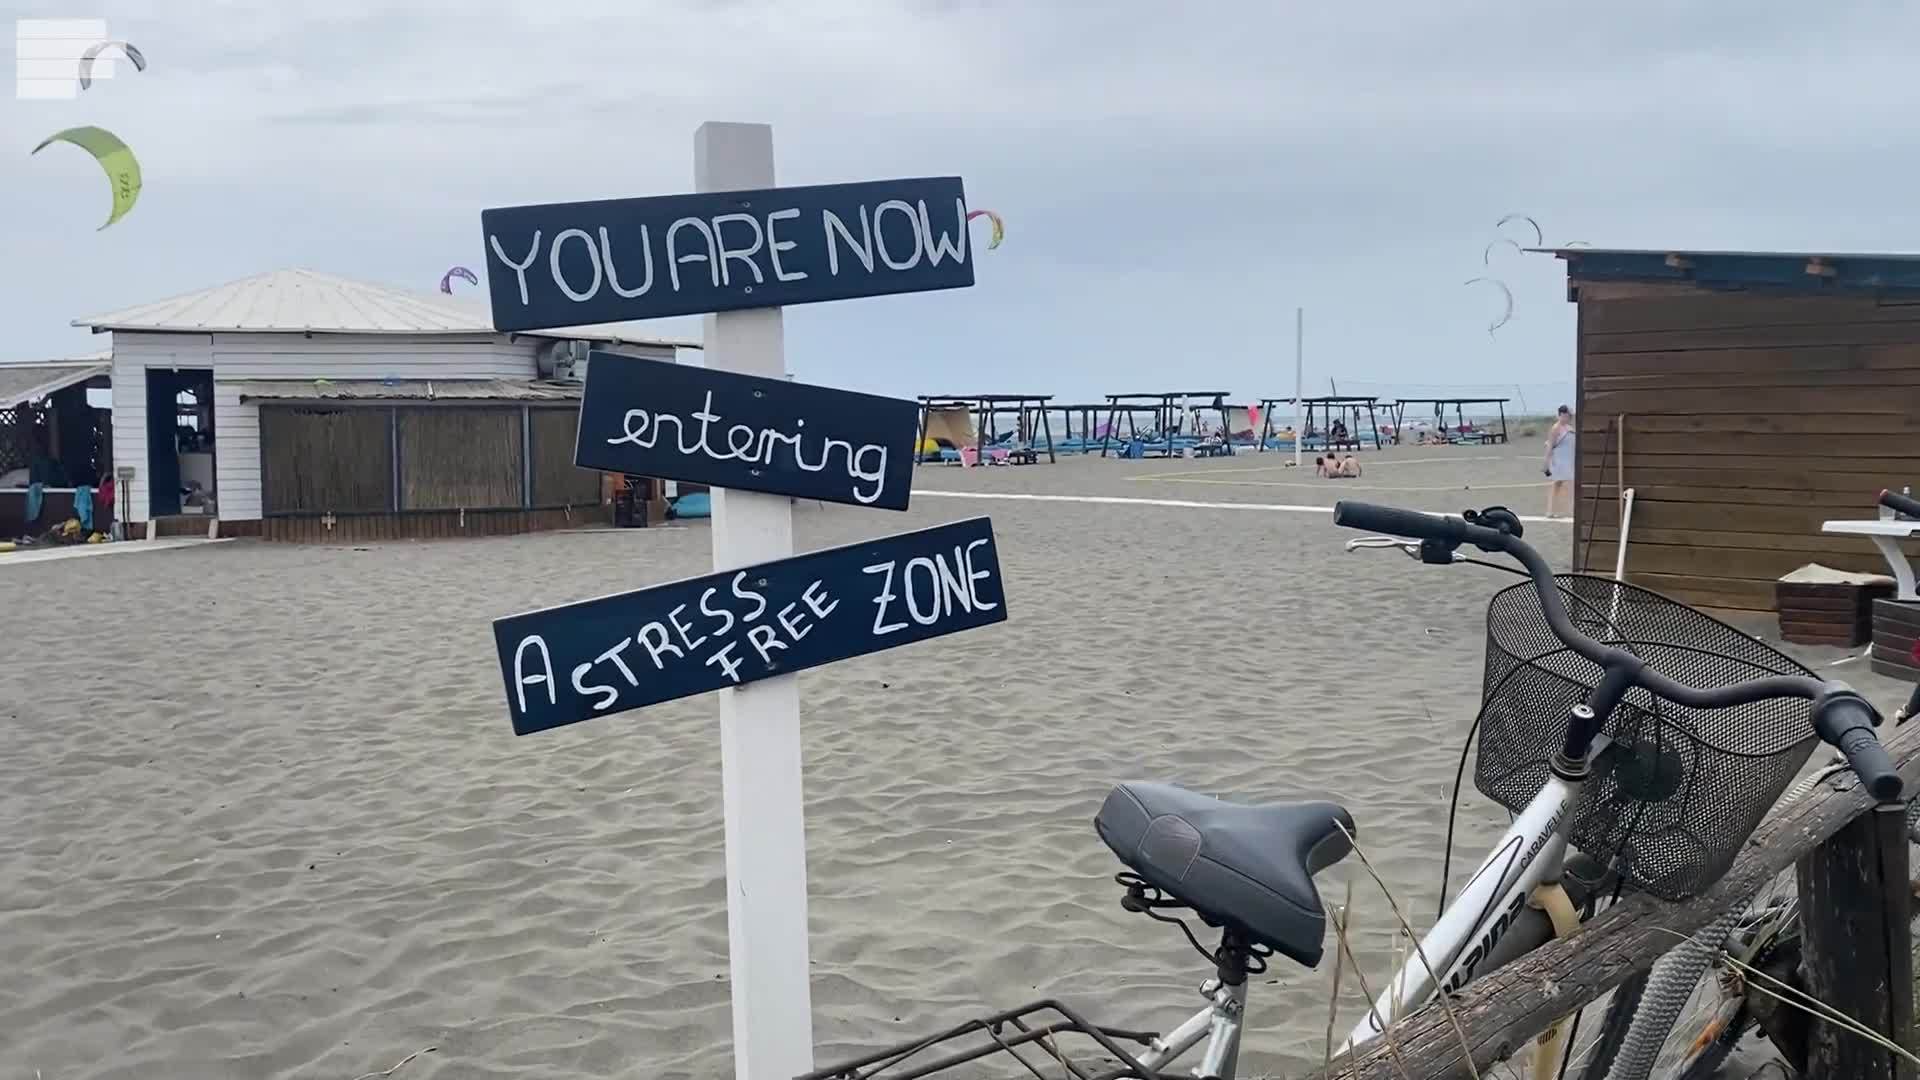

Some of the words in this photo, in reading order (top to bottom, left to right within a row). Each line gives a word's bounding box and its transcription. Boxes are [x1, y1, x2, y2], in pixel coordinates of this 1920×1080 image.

[490, 226, 653, 305] YOU
[667, 208, 808, 291] ARE
[823, 198, 968, 276] NOW
[607, 390, 888, 504] entering
[514, 634, 556, 713] A
[571, 571, 767, 710] STRESS
[705, 579, 839, 683] FREE
[863, 538, 997, 636] ZONE
[1520, 799, 1569, 868] CARAVELLE
